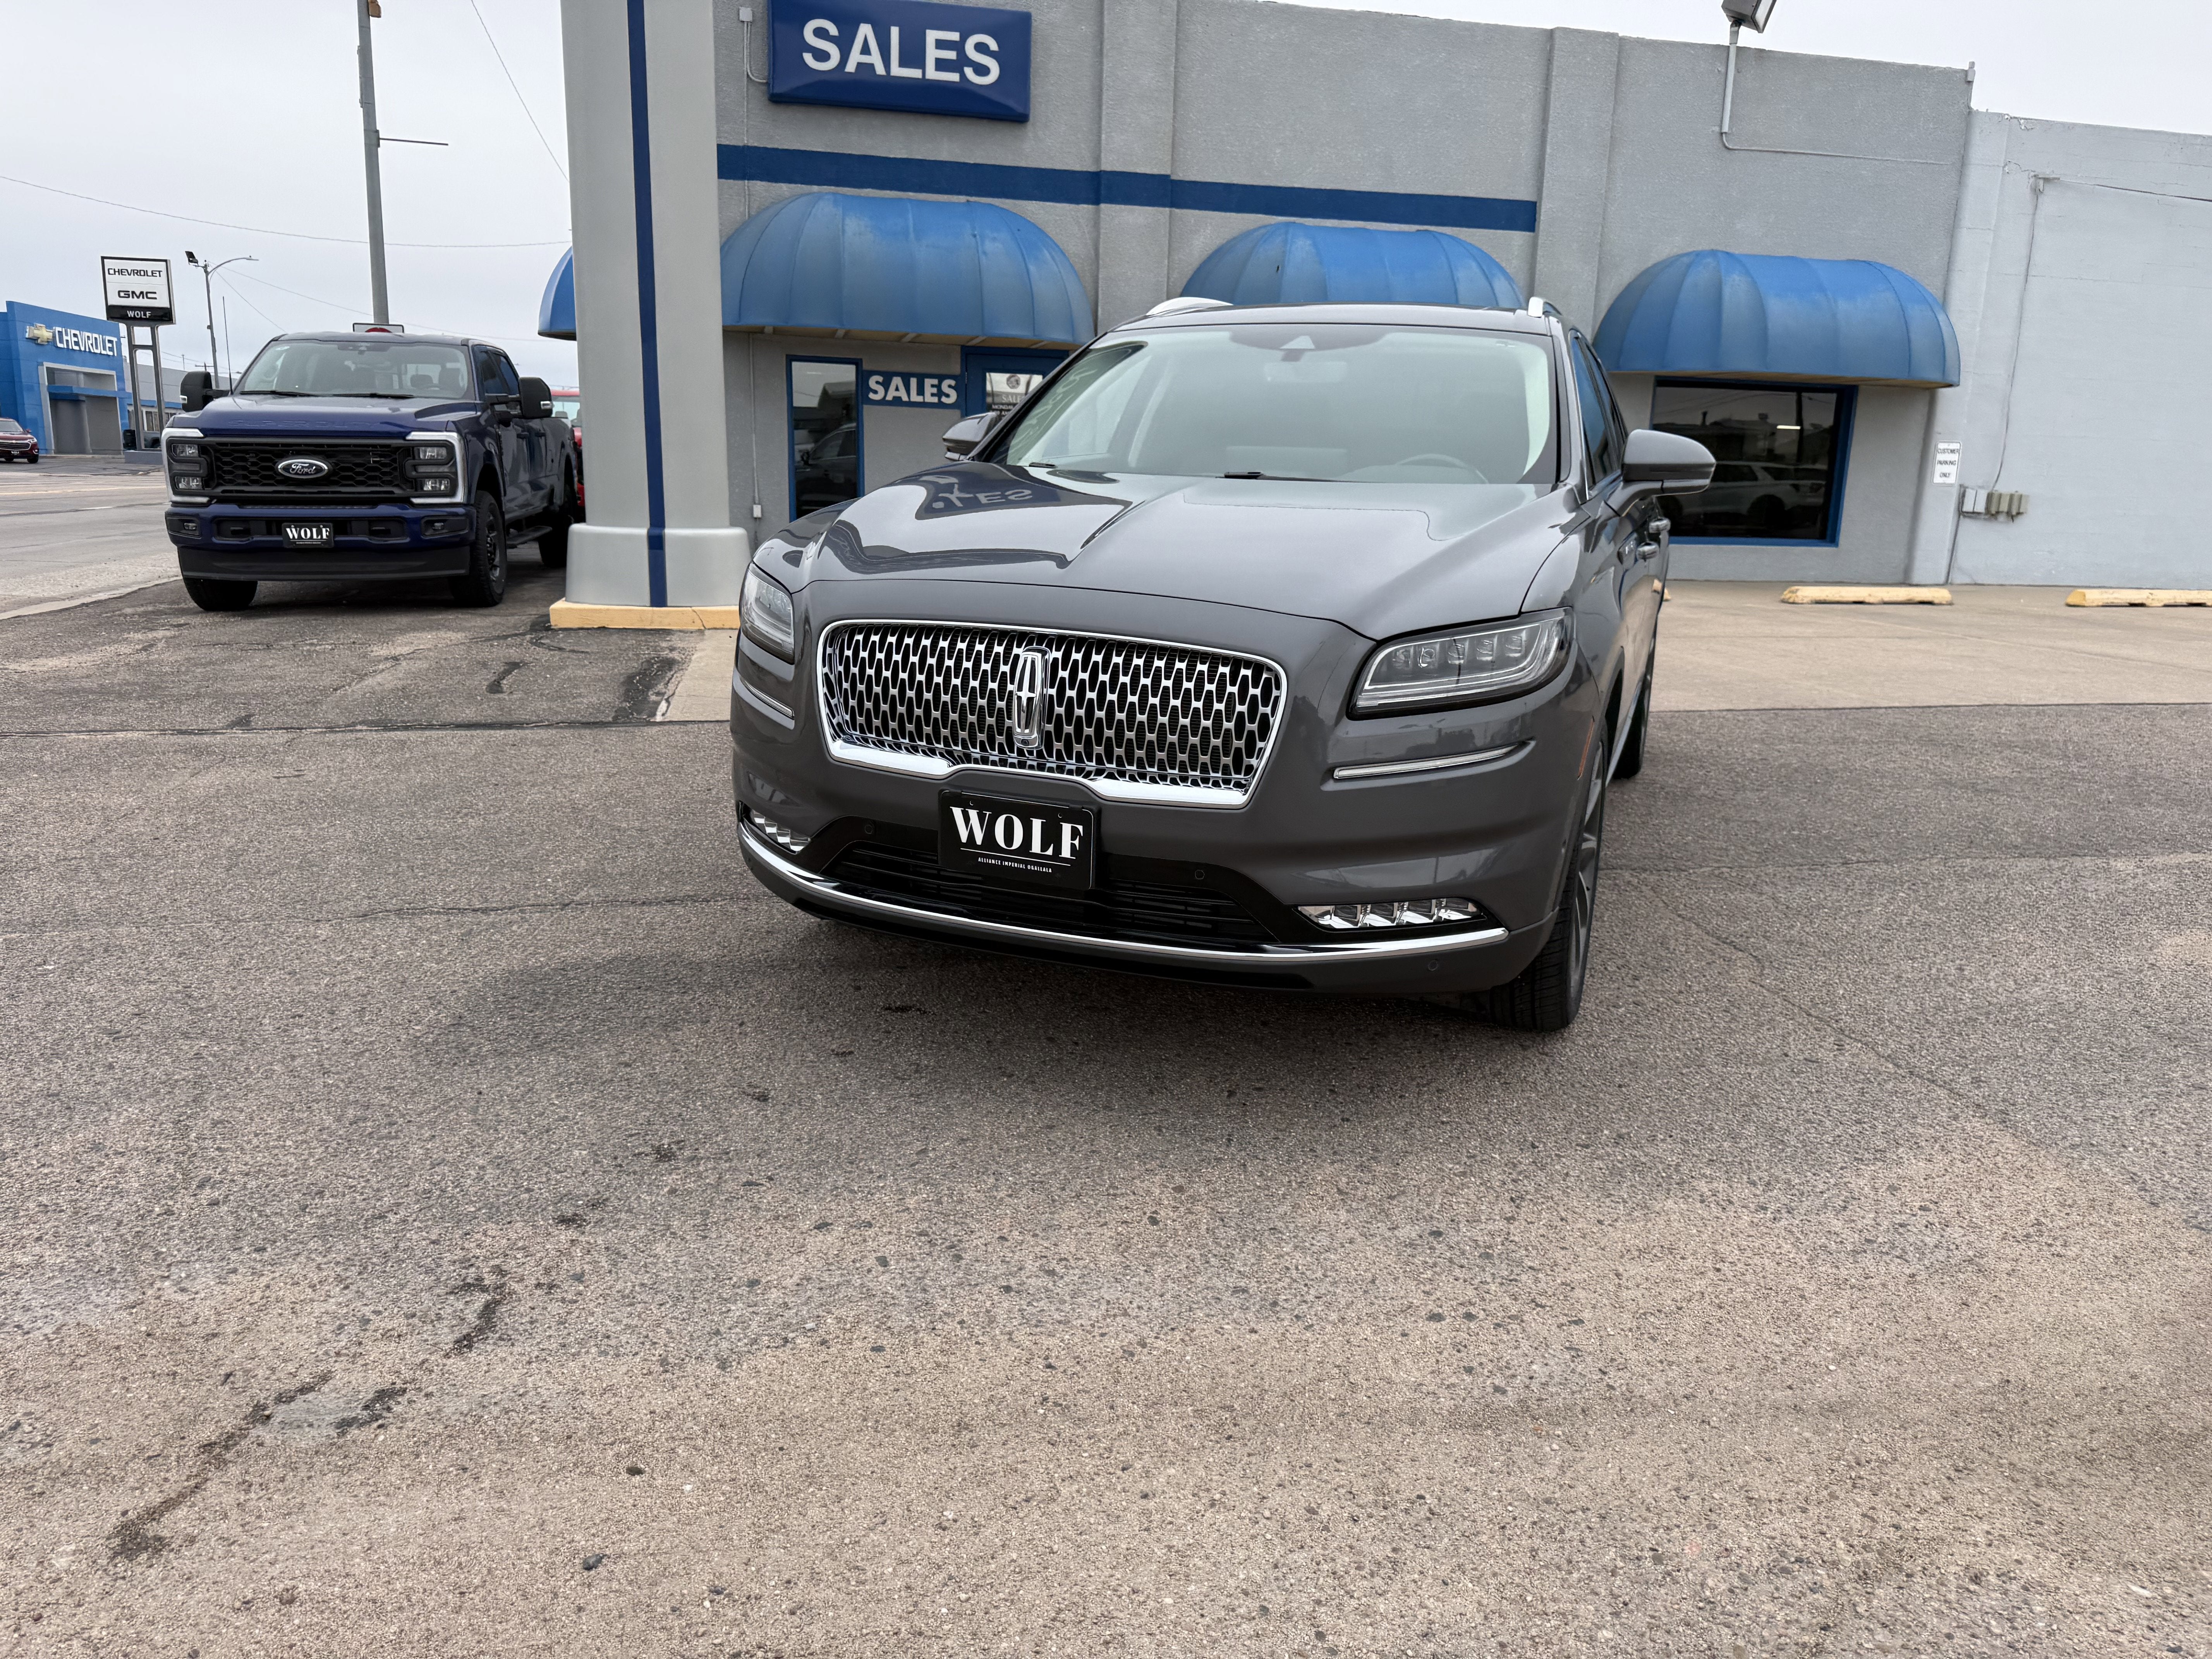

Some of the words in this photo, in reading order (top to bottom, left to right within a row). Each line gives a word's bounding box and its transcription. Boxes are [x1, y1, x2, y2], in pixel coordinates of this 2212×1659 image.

[802, 18, 1000, 85] SALES
[108, 268, 163, 277] CHEVROLET
[117, 290, 157, 300] GMC
[53, 326, 117, 357] CHEVROLET
[868, 375, 957, 404] SALES
[290, 463, 316, 474] Ford
[286, 527, 330, 539] WOLF
[950, 806, 1083, 859] WOLF
[978, 857, 1001, 865] ALLIANCE
[1002, 861, 1025, 869] IMPERIAL
